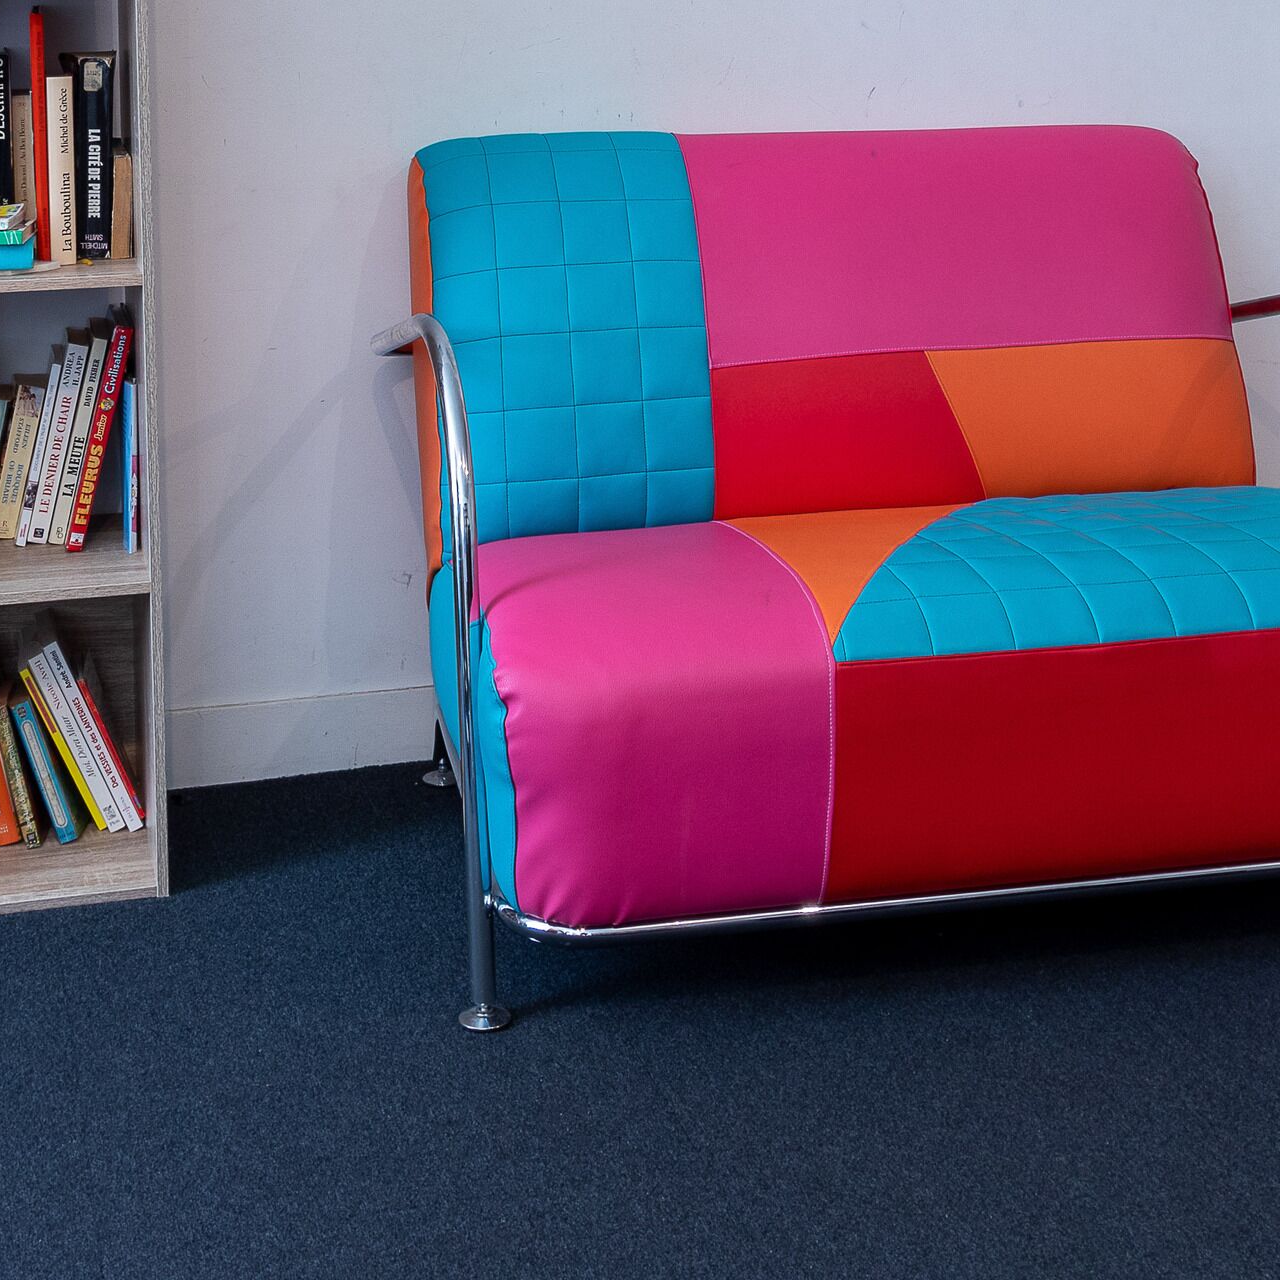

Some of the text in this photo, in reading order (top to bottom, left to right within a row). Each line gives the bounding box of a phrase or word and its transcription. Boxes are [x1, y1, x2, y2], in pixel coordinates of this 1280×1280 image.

[58, 88, 72, 252] La Bouboulina Michel de Grèce
[88, 128, 102, 219] LA CITÉ DE PIERRE
[73, 354, 84, 375] JAPP
[10, 463, 25, 504] BOUQUET
[39, 351, 75, 513] LE DENIER DE CHAIR ANDREA
[62, 358, 101, 497] LA MEUTE DAVID FISHER
[74, 335, 126, 526] FLEURUS Junior Civilisations
[35, 660, 87, 764] Dora Maar Nicole Avril
[63, 670, 119, 789] Des VESSIES LANTERNES André
